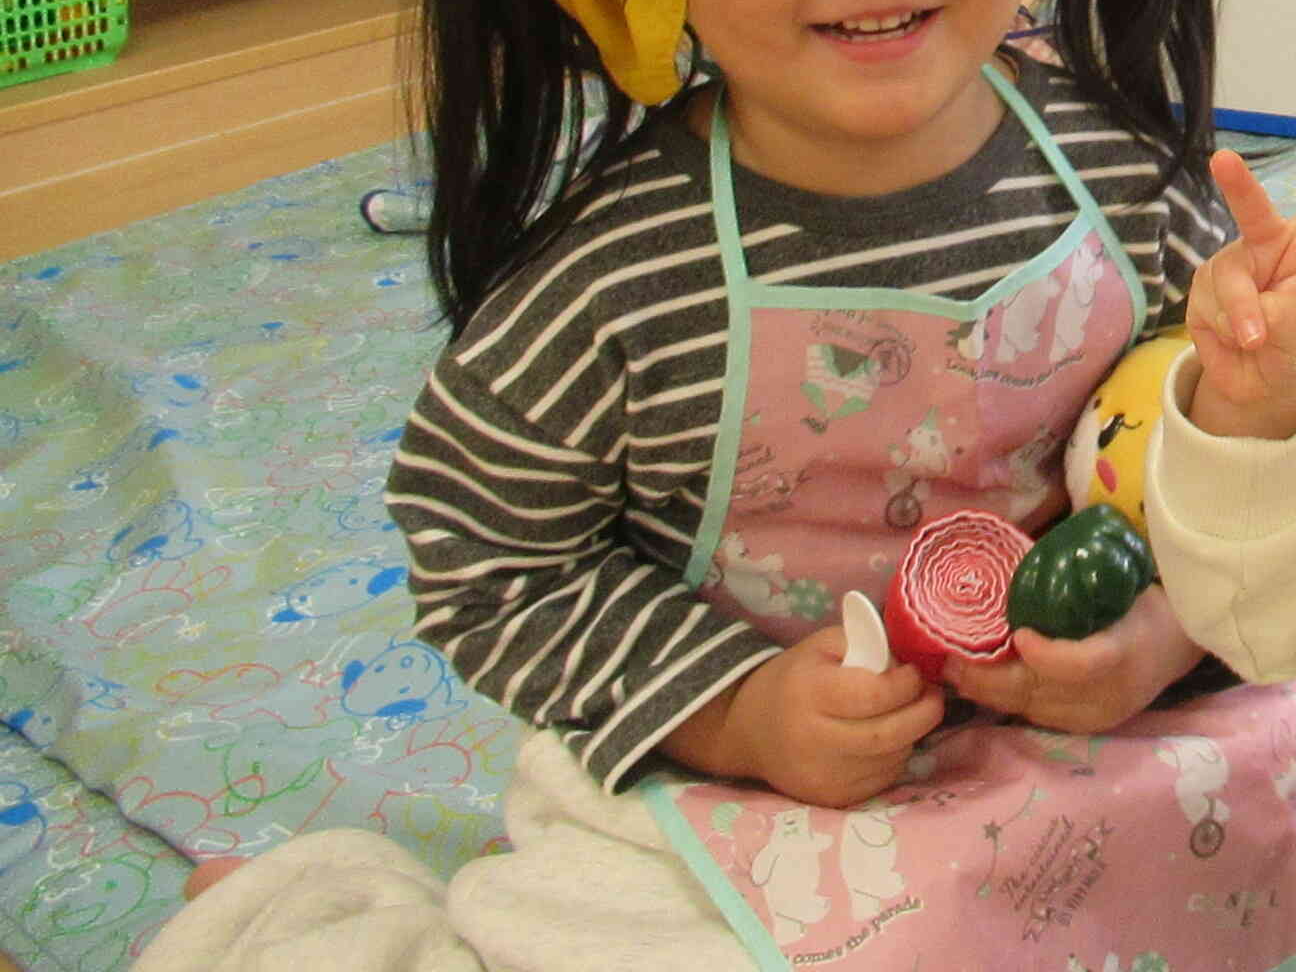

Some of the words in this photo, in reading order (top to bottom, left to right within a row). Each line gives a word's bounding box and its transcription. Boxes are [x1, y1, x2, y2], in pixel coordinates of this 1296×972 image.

[792, 945, 843, 965] comes
[845, 927, 871, 950] the
[871, 896, 922, 932] parade
